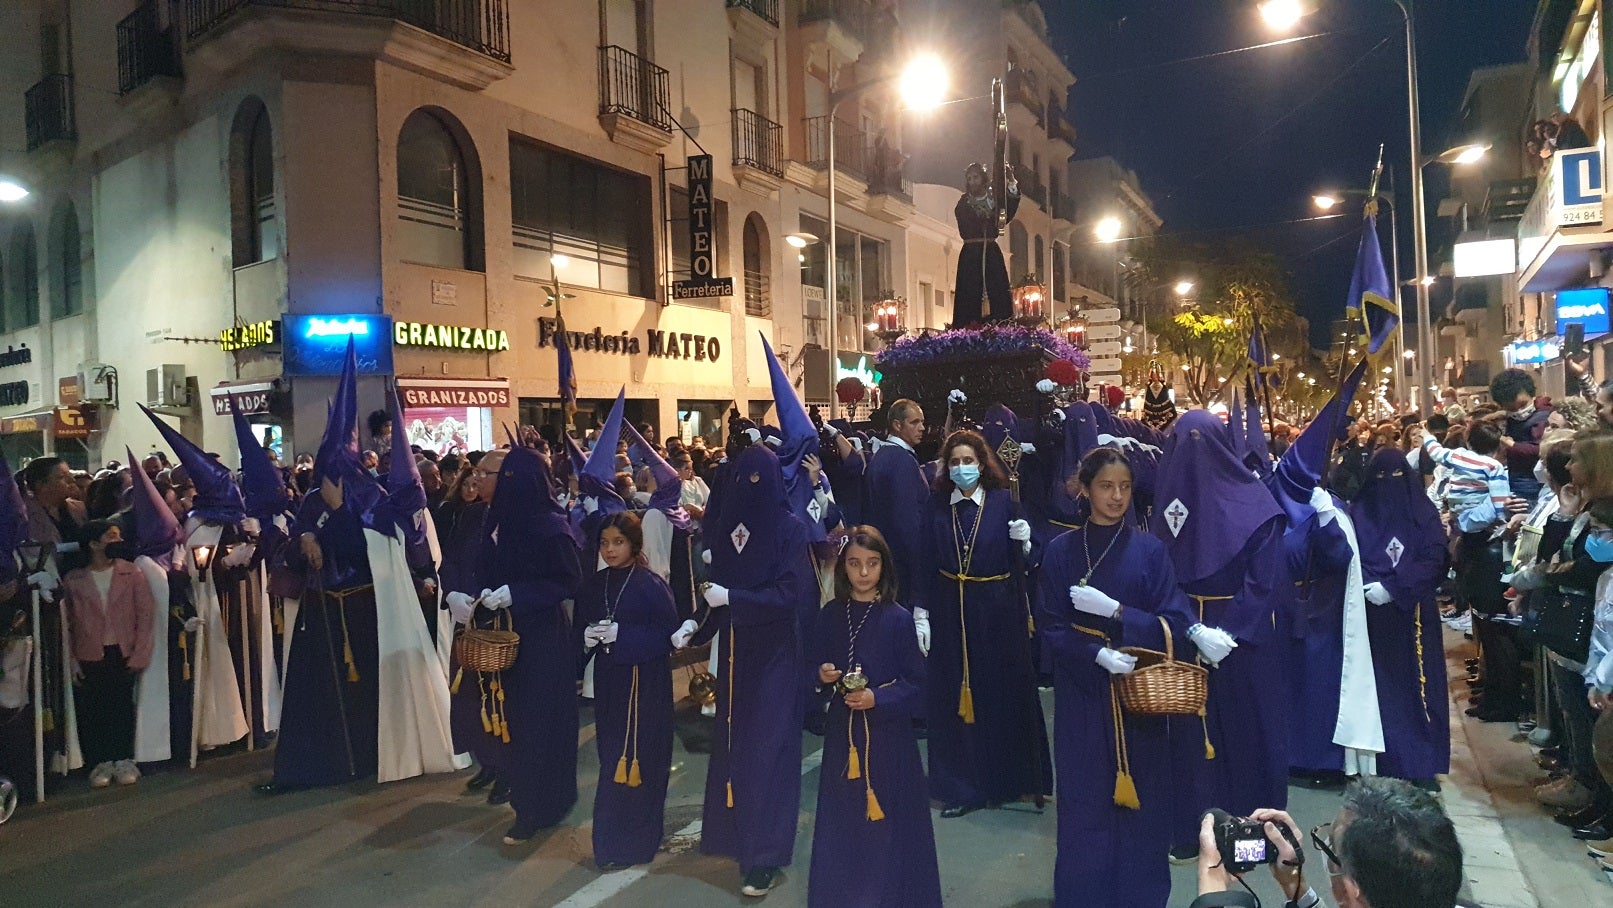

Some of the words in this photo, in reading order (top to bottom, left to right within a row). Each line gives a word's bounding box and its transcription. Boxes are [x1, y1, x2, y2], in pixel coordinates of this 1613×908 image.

[690, 159, 711, 276] MATEO
[1563, 211, 1581, 222] 924
[1583, 210, 1596, 221] 84
[395, 321, 510, 351] GRANIZADA
[647, 328, 721, 364] MATEO
[215, 393, 269, 413] HEADOS
[406, 389, 507, 405] GRANIZADOS
